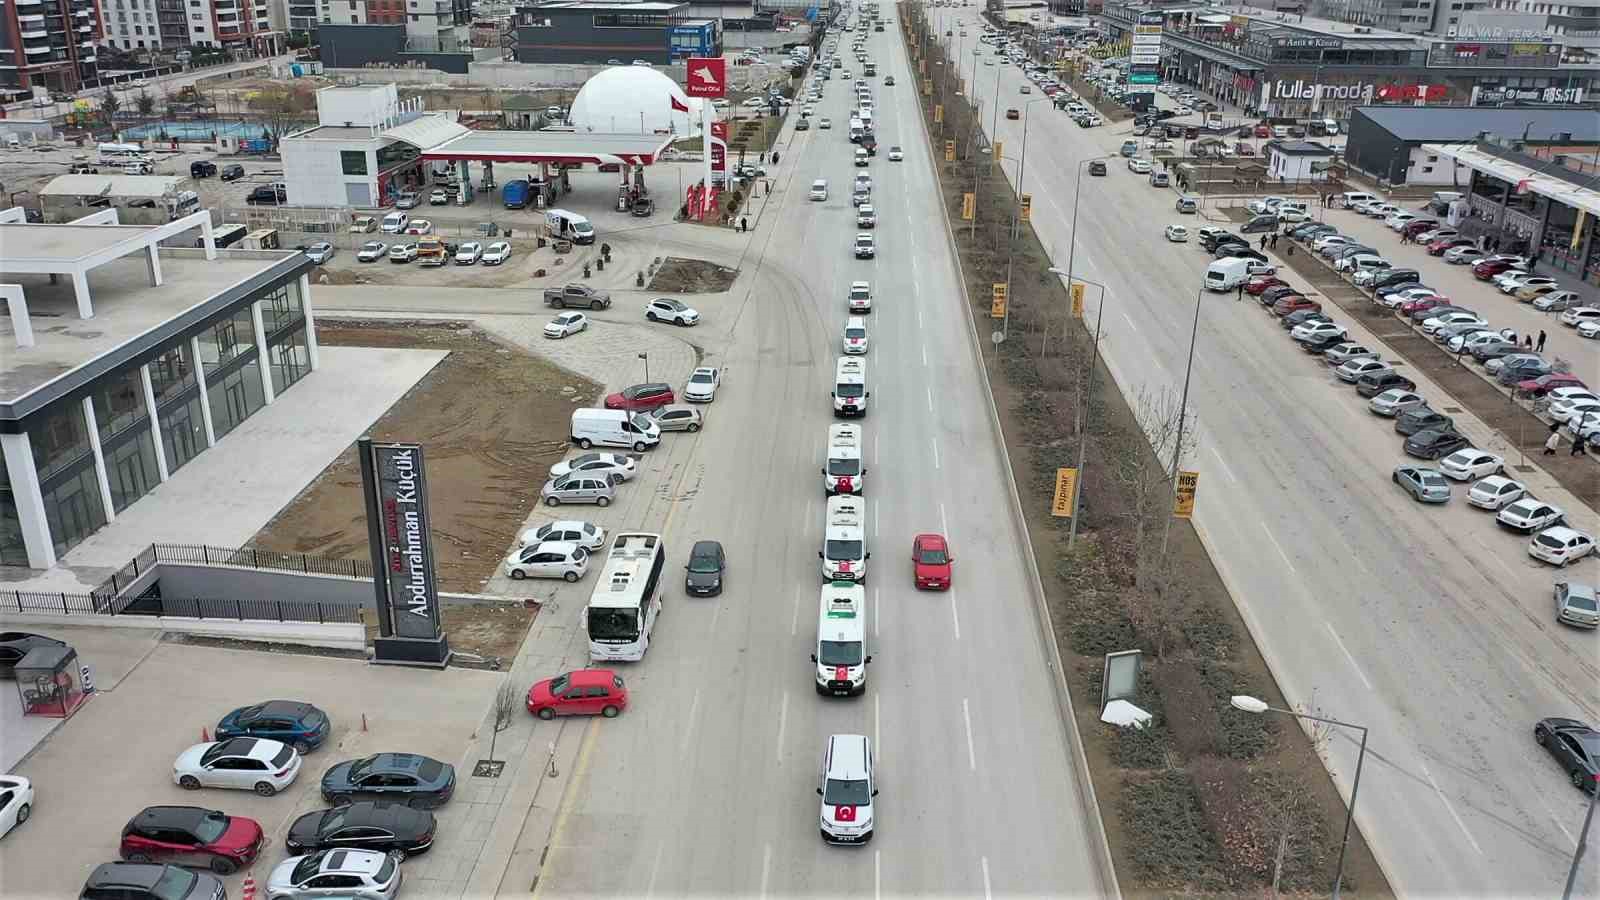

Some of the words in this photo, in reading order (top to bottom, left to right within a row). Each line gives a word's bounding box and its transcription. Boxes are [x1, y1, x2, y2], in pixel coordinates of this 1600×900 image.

[1275, 80, 1314, 99] fulla
[392, 449, 418, 504] Küçük
[402, 511, 429, 618] Abdurrahman
